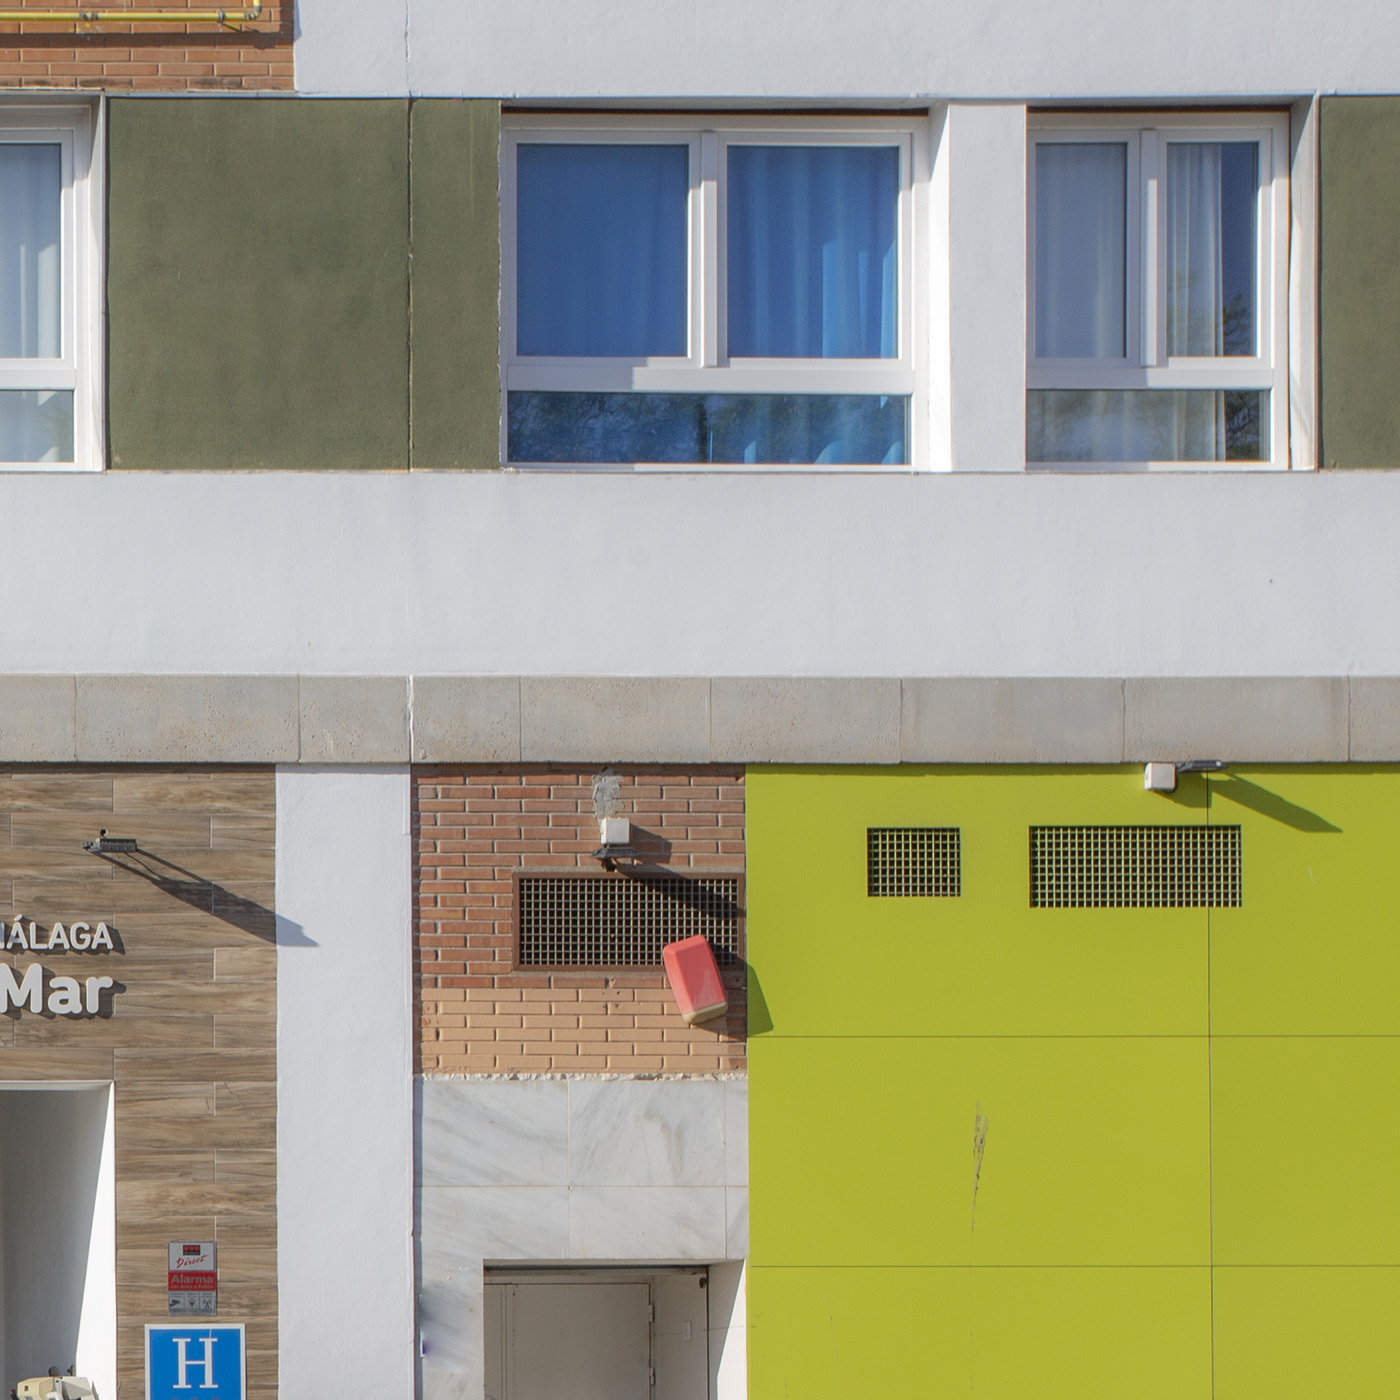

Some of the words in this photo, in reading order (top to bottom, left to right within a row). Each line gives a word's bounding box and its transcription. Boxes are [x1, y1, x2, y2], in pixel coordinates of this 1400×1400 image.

[176, 1254, 209, 1269] Direct
[171, 1273, 214, 1283] Alarma
[172, 1337, 219, 1389] H
